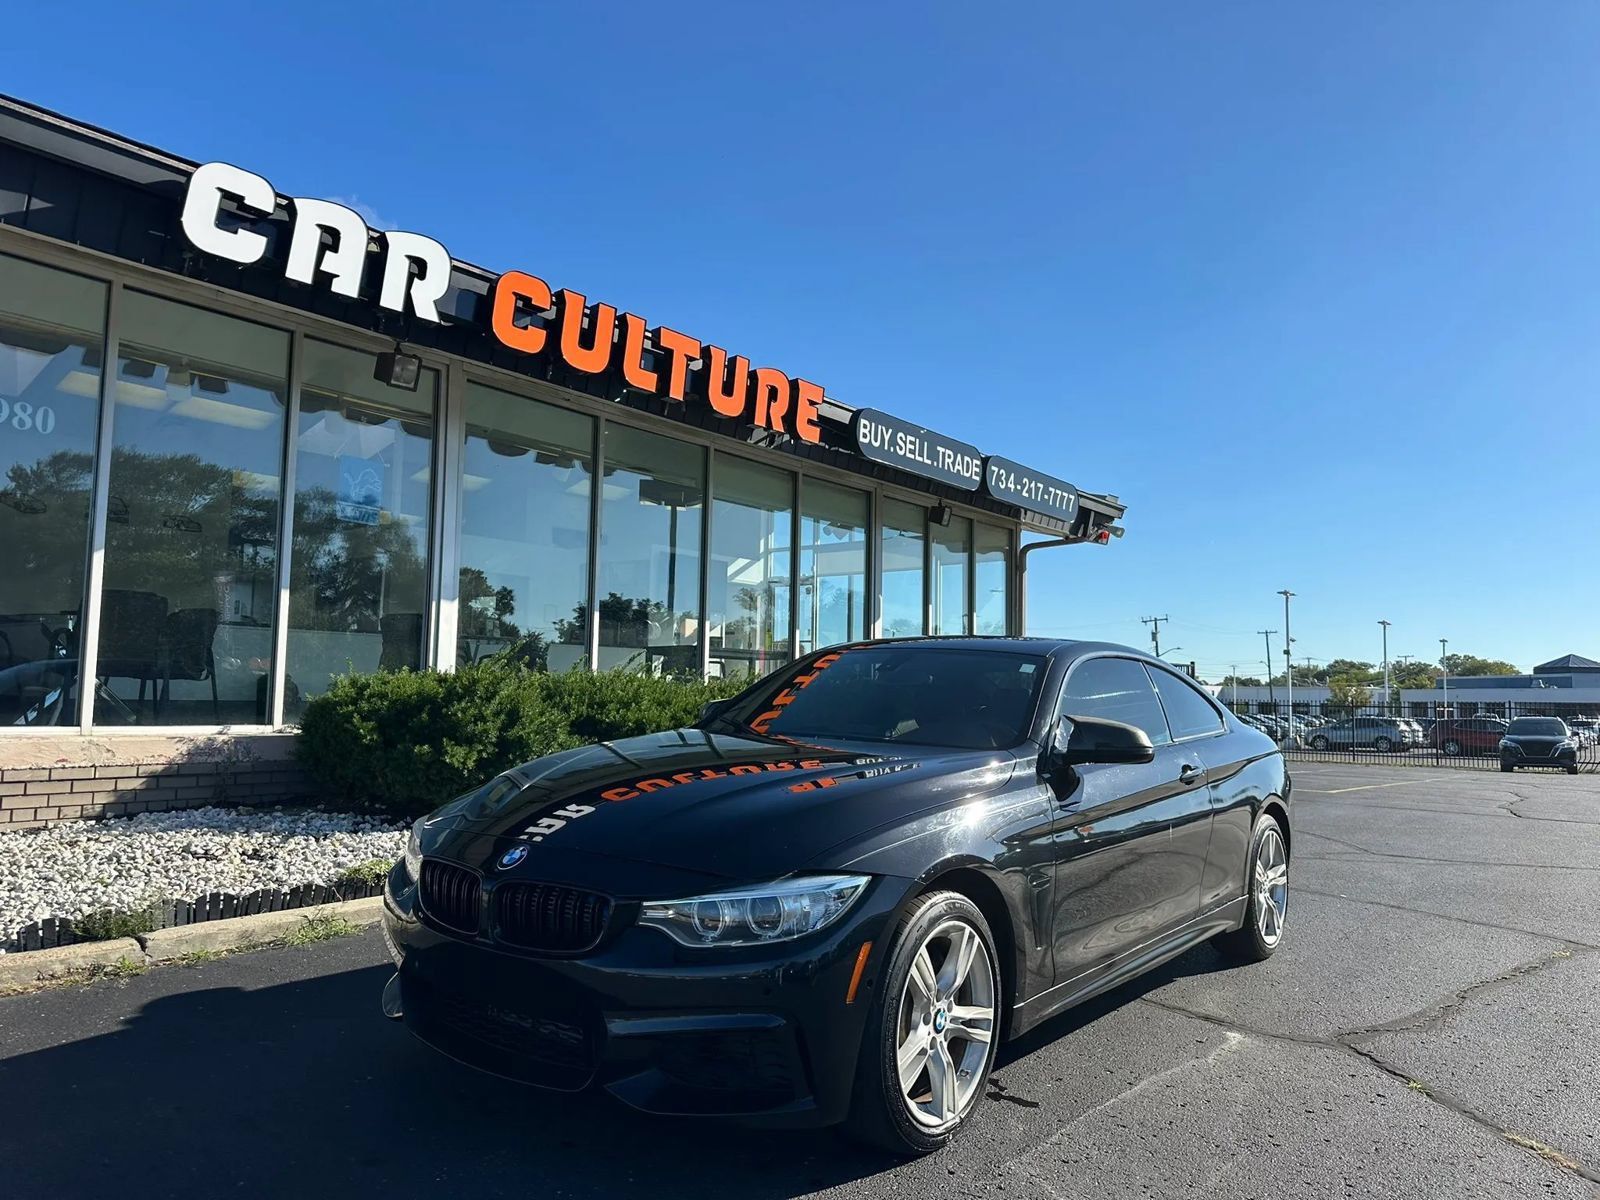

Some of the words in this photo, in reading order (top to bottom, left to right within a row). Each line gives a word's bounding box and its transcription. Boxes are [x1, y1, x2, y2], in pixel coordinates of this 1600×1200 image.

[181, 161, 451, 324] CAR
[492, 270, 824, 444] CULTURE
[991, 465, 1075, 512] 734-217-7777
